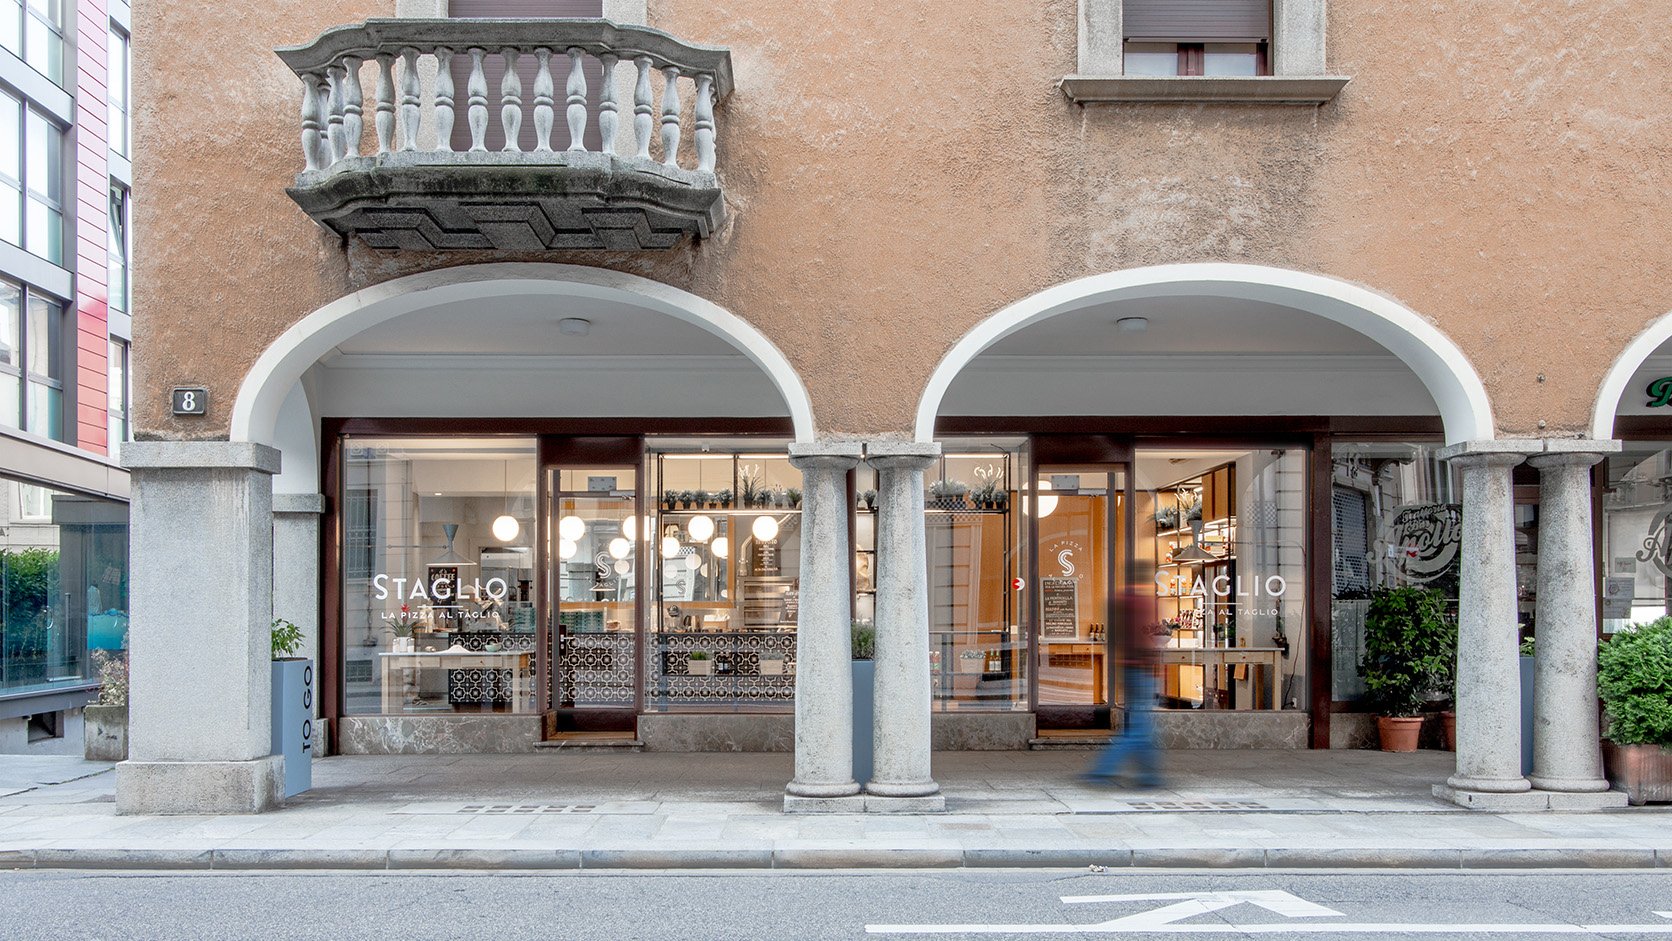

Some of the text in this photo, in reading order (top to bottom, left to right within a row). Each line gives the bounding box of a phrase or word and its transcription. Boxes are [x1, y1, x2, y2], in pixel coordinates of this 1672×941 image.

[182, 391, 196, 411] 8
[1060, 540, 1083, 552] PIZZA
[594, 551, 612, 579] S
[1057, 548, 1075, 577] S
[373, 573, 508, 600] STAGLIO
[1154, 570, 1287, 597] STAGLIO
[381, 611, 500, 619] LA PIZZA AL TAGLIO
[1218, 608, 1233, 616] AL
[1237, 608, 1279, 616] TAGLIO
[302, 665, 312, 753] TO GO
